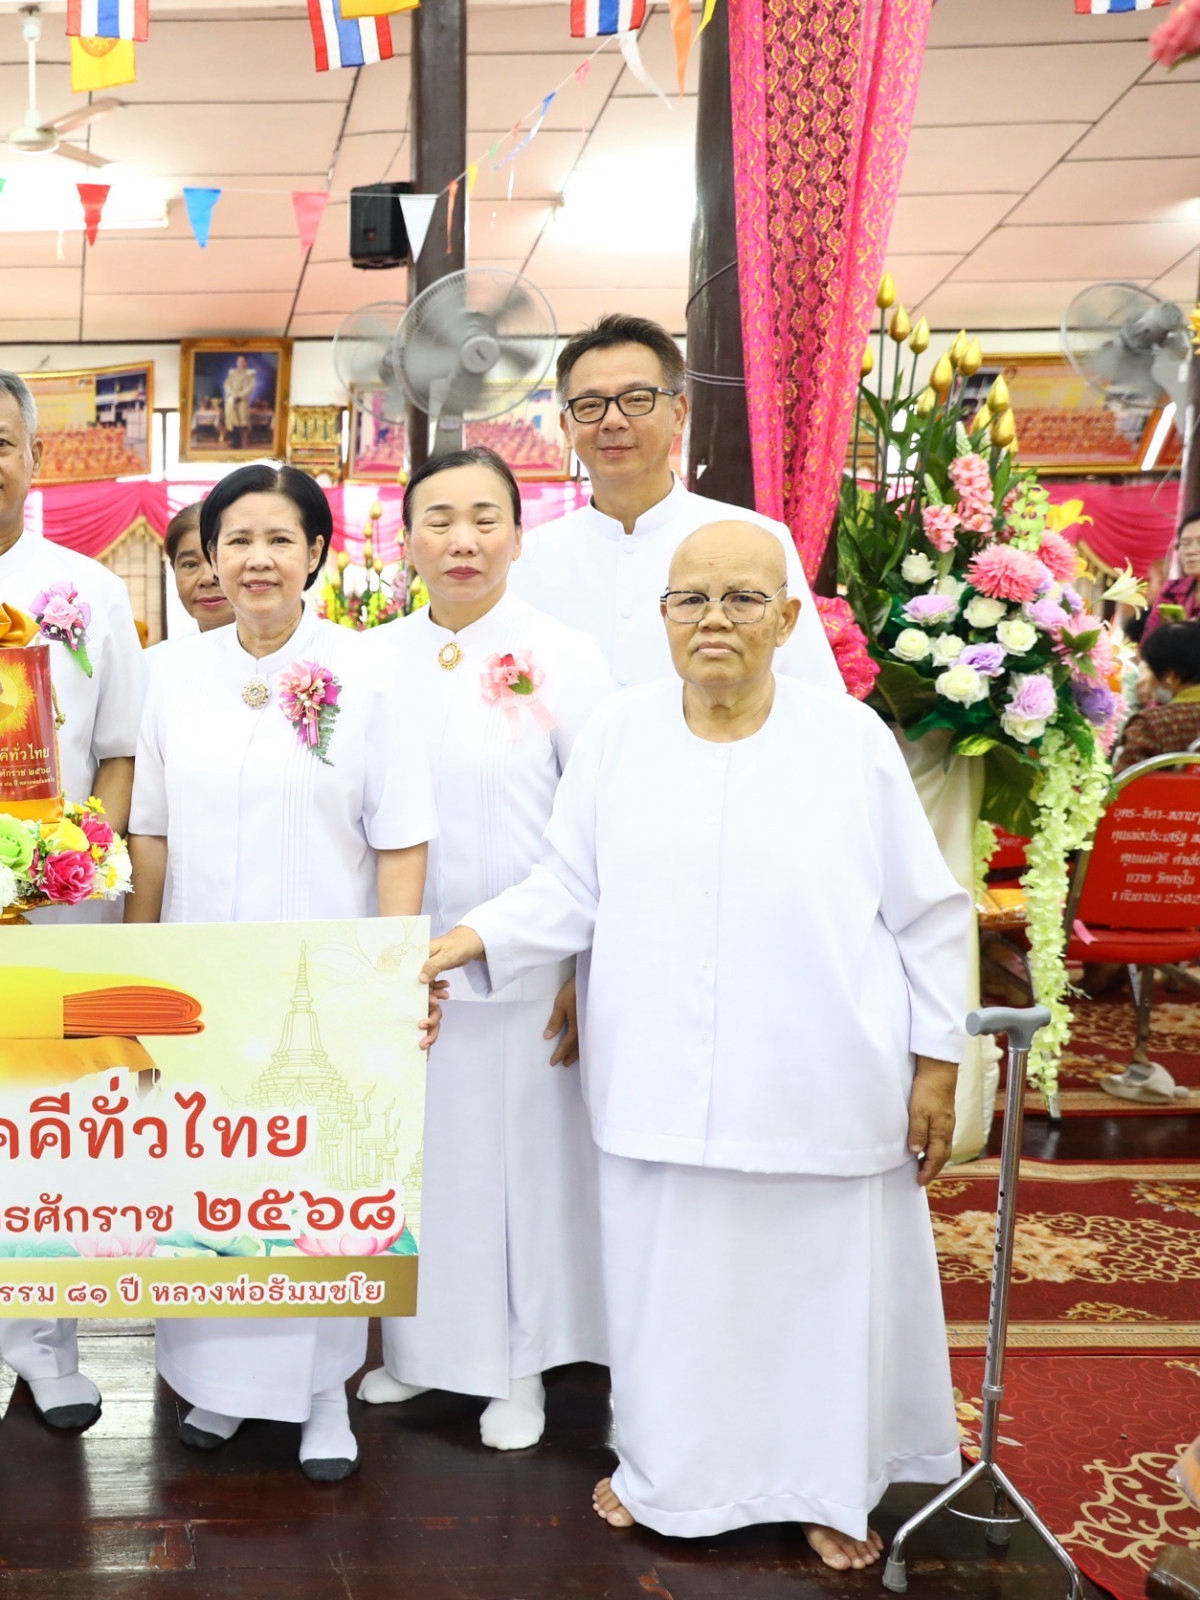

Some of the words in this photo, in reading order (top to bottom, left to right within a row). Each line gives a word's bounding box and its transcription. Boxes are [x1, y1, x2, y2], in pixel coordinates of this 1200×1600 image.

[193, 1188, 396, 1232] ๒๕๖๘
[67, 1285, 107, 1304] ๘๑
[120, 1276, 139, 1302] ปี
[152, 1275, 383, 1303] หลวงพ่อธัมมชโย
